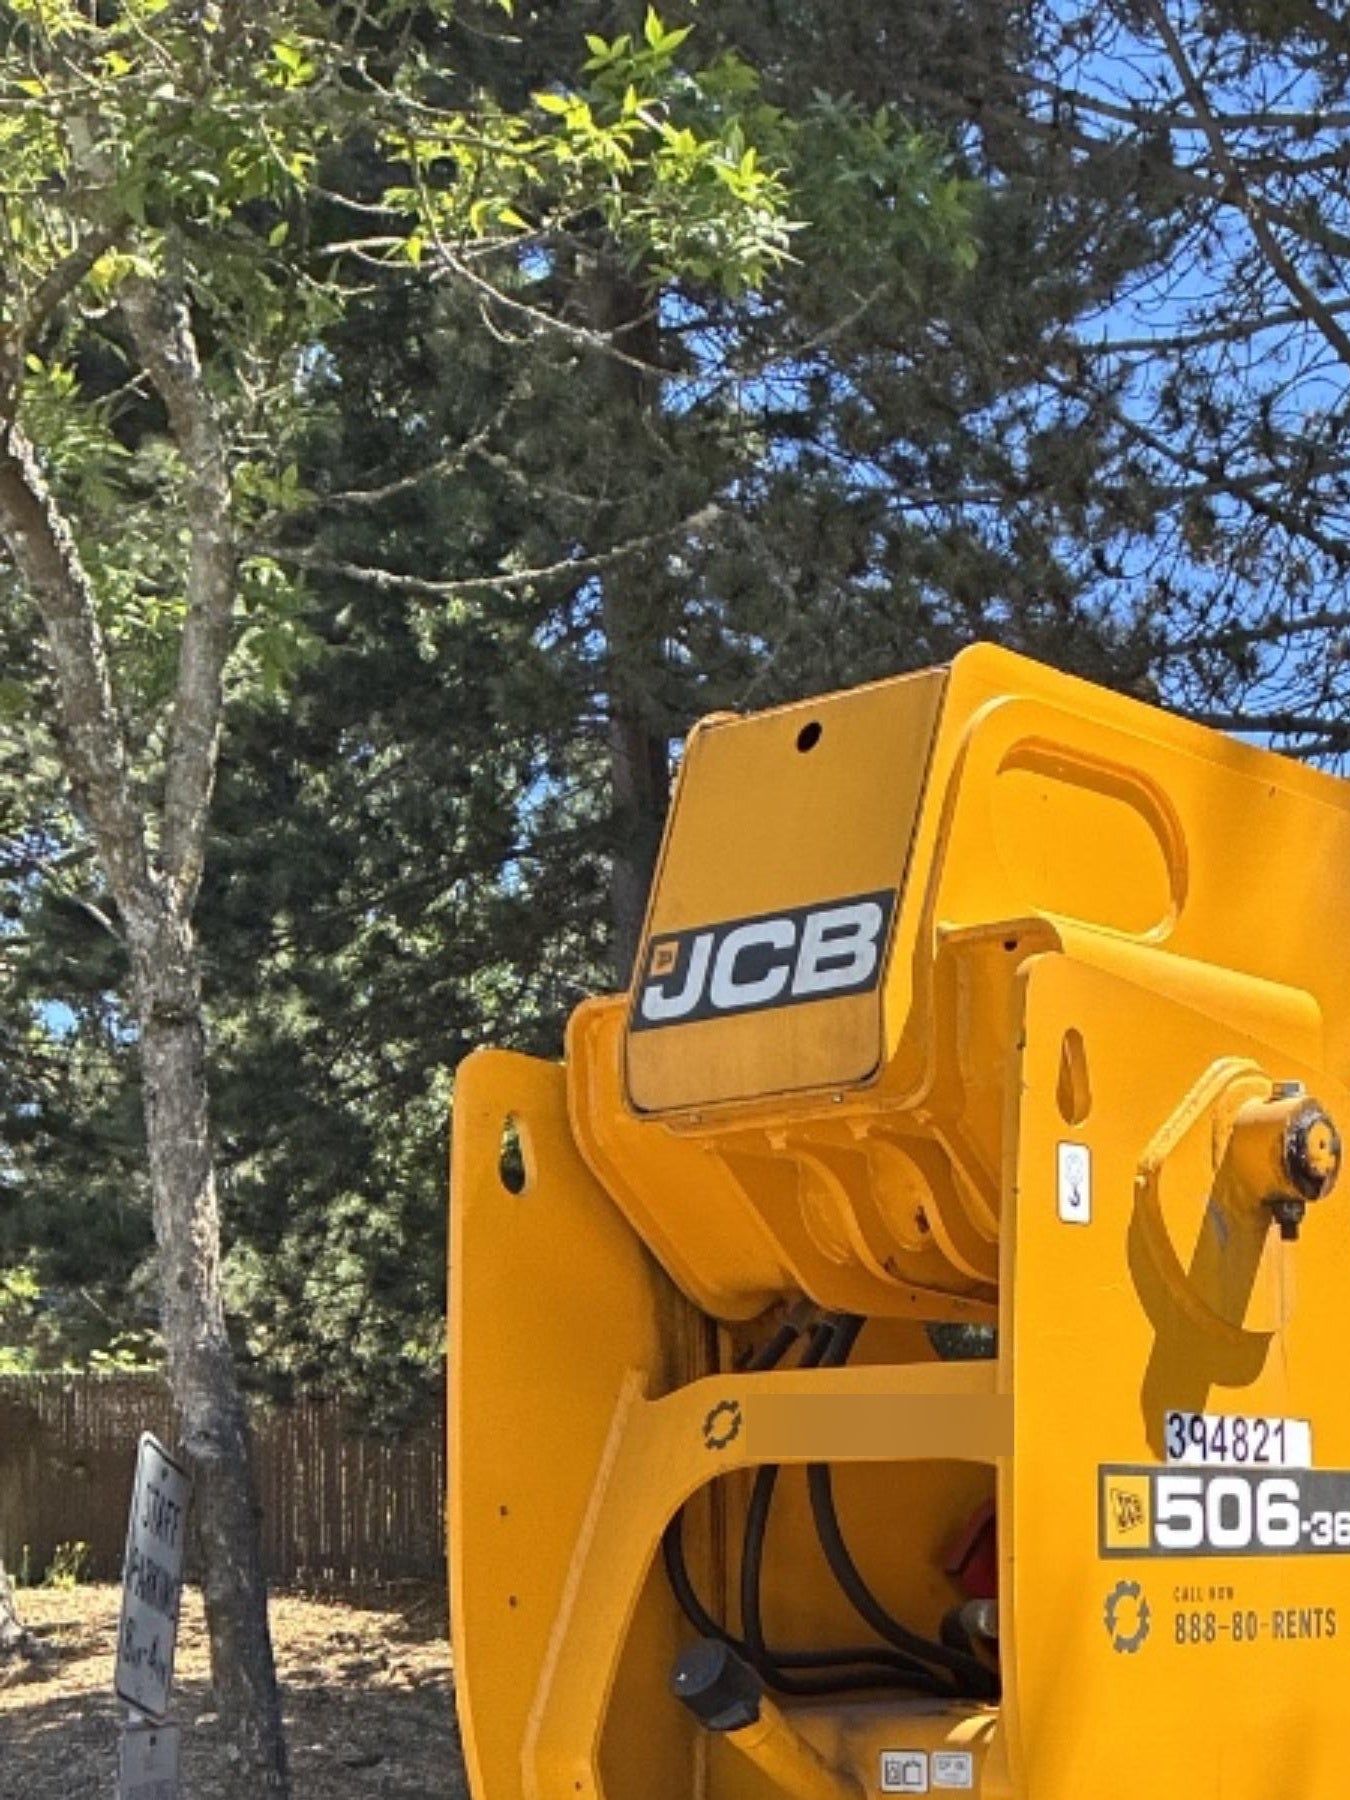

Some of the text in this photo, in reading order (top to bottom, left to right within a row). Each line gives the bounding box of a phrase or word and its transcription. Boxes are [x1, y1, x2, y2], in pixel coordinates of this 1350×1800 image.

[641, 902, 883, 1020] JCB
[1167, 1412, 1287, 1463] 394821
[1173, 1585, 1204, 1603] CALL
[1174, 1607, 1336, 1645] 888-80-RENTS
